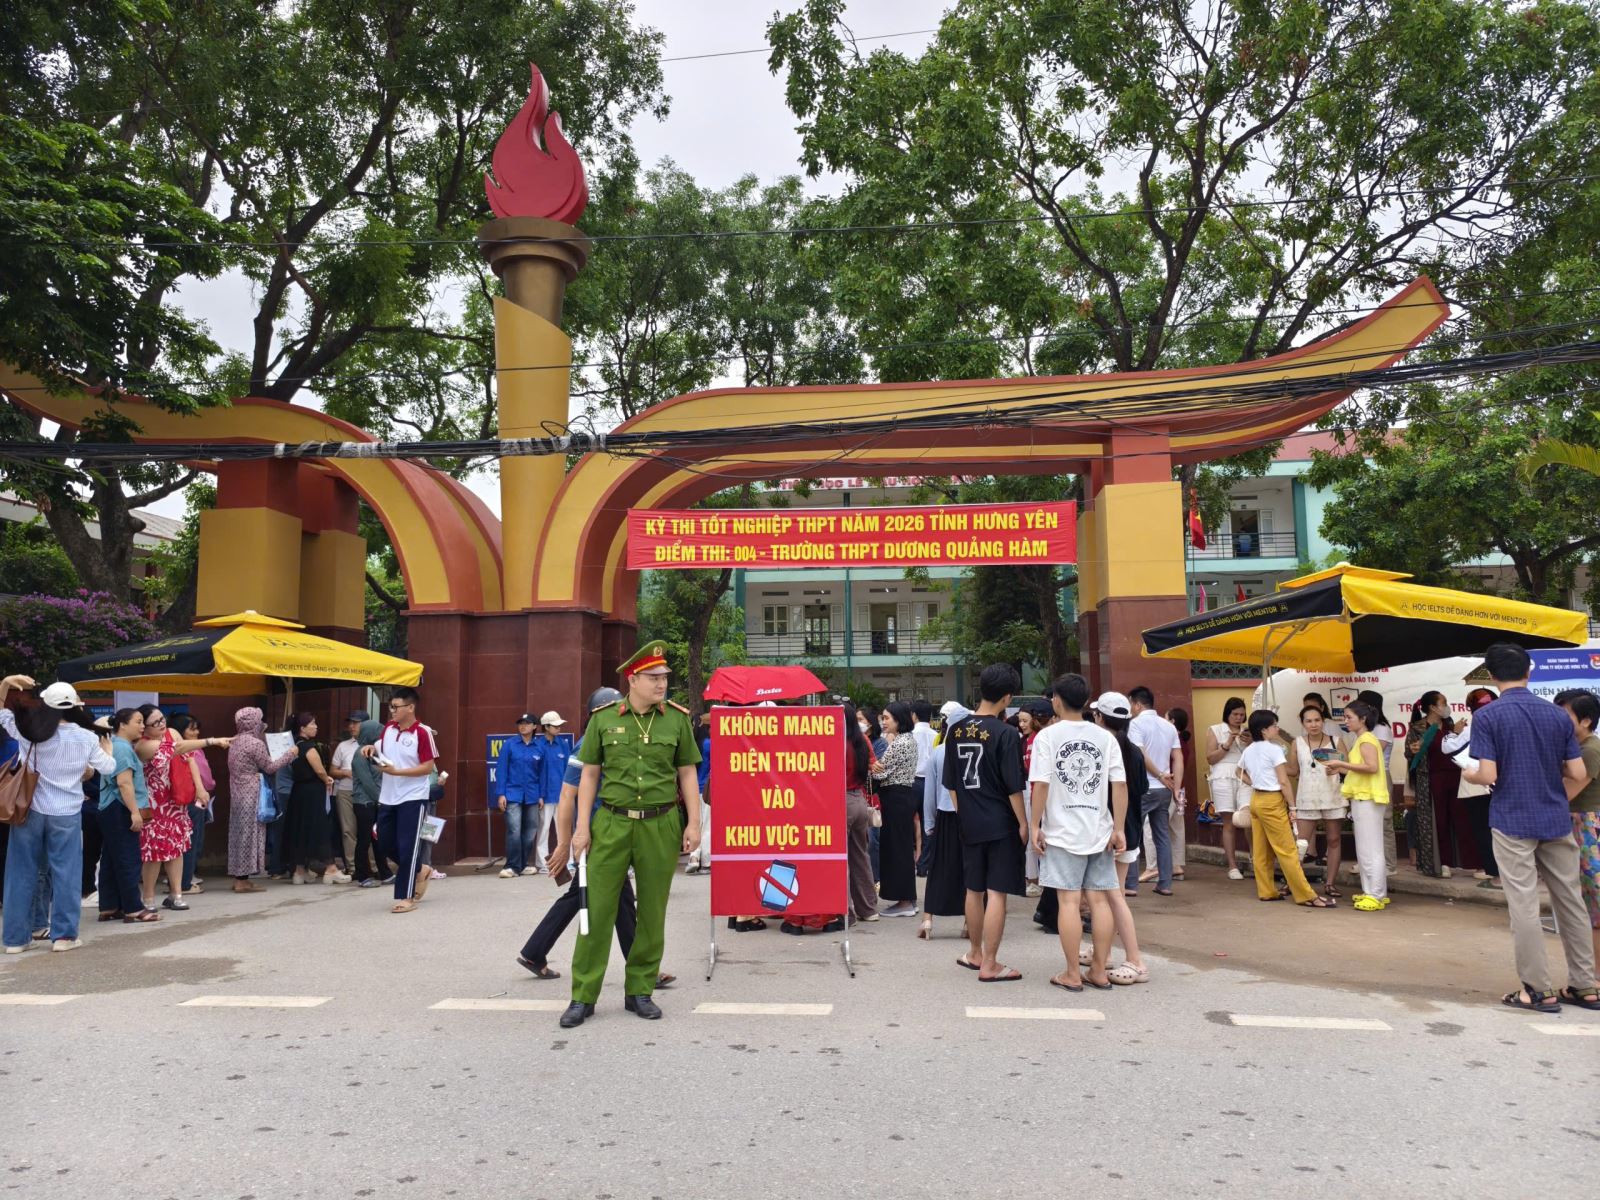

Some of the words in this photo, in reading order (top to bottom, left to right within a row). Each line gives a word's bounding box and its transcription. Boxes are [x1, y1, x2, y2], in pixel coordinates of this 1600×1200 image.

[671, 519, 695, 535] THI
[700, 513, 728, 535] TỐT
[733, 514, 792, 537] NGHIỆP
[797, 516, 837, 533] THPT
[841, 513, 880, 532] NĂM
[884, 515, 924, 532] 2026
[929, 509, 968, 531] TỈNH
[973, 511, 1020, 530] HƯNG
[1025, 509, 1058, 529] YÊN
[655, 539, 696, 561] ĐIỂM
[700, 545, 730, 561] THI:
[734, 546, 757, 561] 004
[770, 540, 835, 560] TRƯỜNG
[840, 543, 880, 560] THPT
[884, 540, 941, 559] DƯƠNG
[946, 536, 1004, 559] QUẢNG
[1009, 537, 1048, 557] HÀM
[1253, 606, 1277, 617] MENTOR
[1427, 604, 1445, 613] IELTS
[1501, 614, 1527, 625] MENTOR
[350, 668, 372, 676] MENTOR
[756, 688, 782, 696] Bata
[1533, 686, 1554, 697] ĐIỆN
[719, 712, 778, 736] KHÔNG
[784, 715, 835, 736] MANG
[730, 748, 770, 777] ĐIỆN
[775, 751, 825, 777] THOẠI
[957, 742, 983, 789] 7
[761, 784, 795, 809] VÀO
[725, 826, 760, 846] KHU
[765, 823, 800, 850] VỰC
[805, 825, 832, 846] THI
